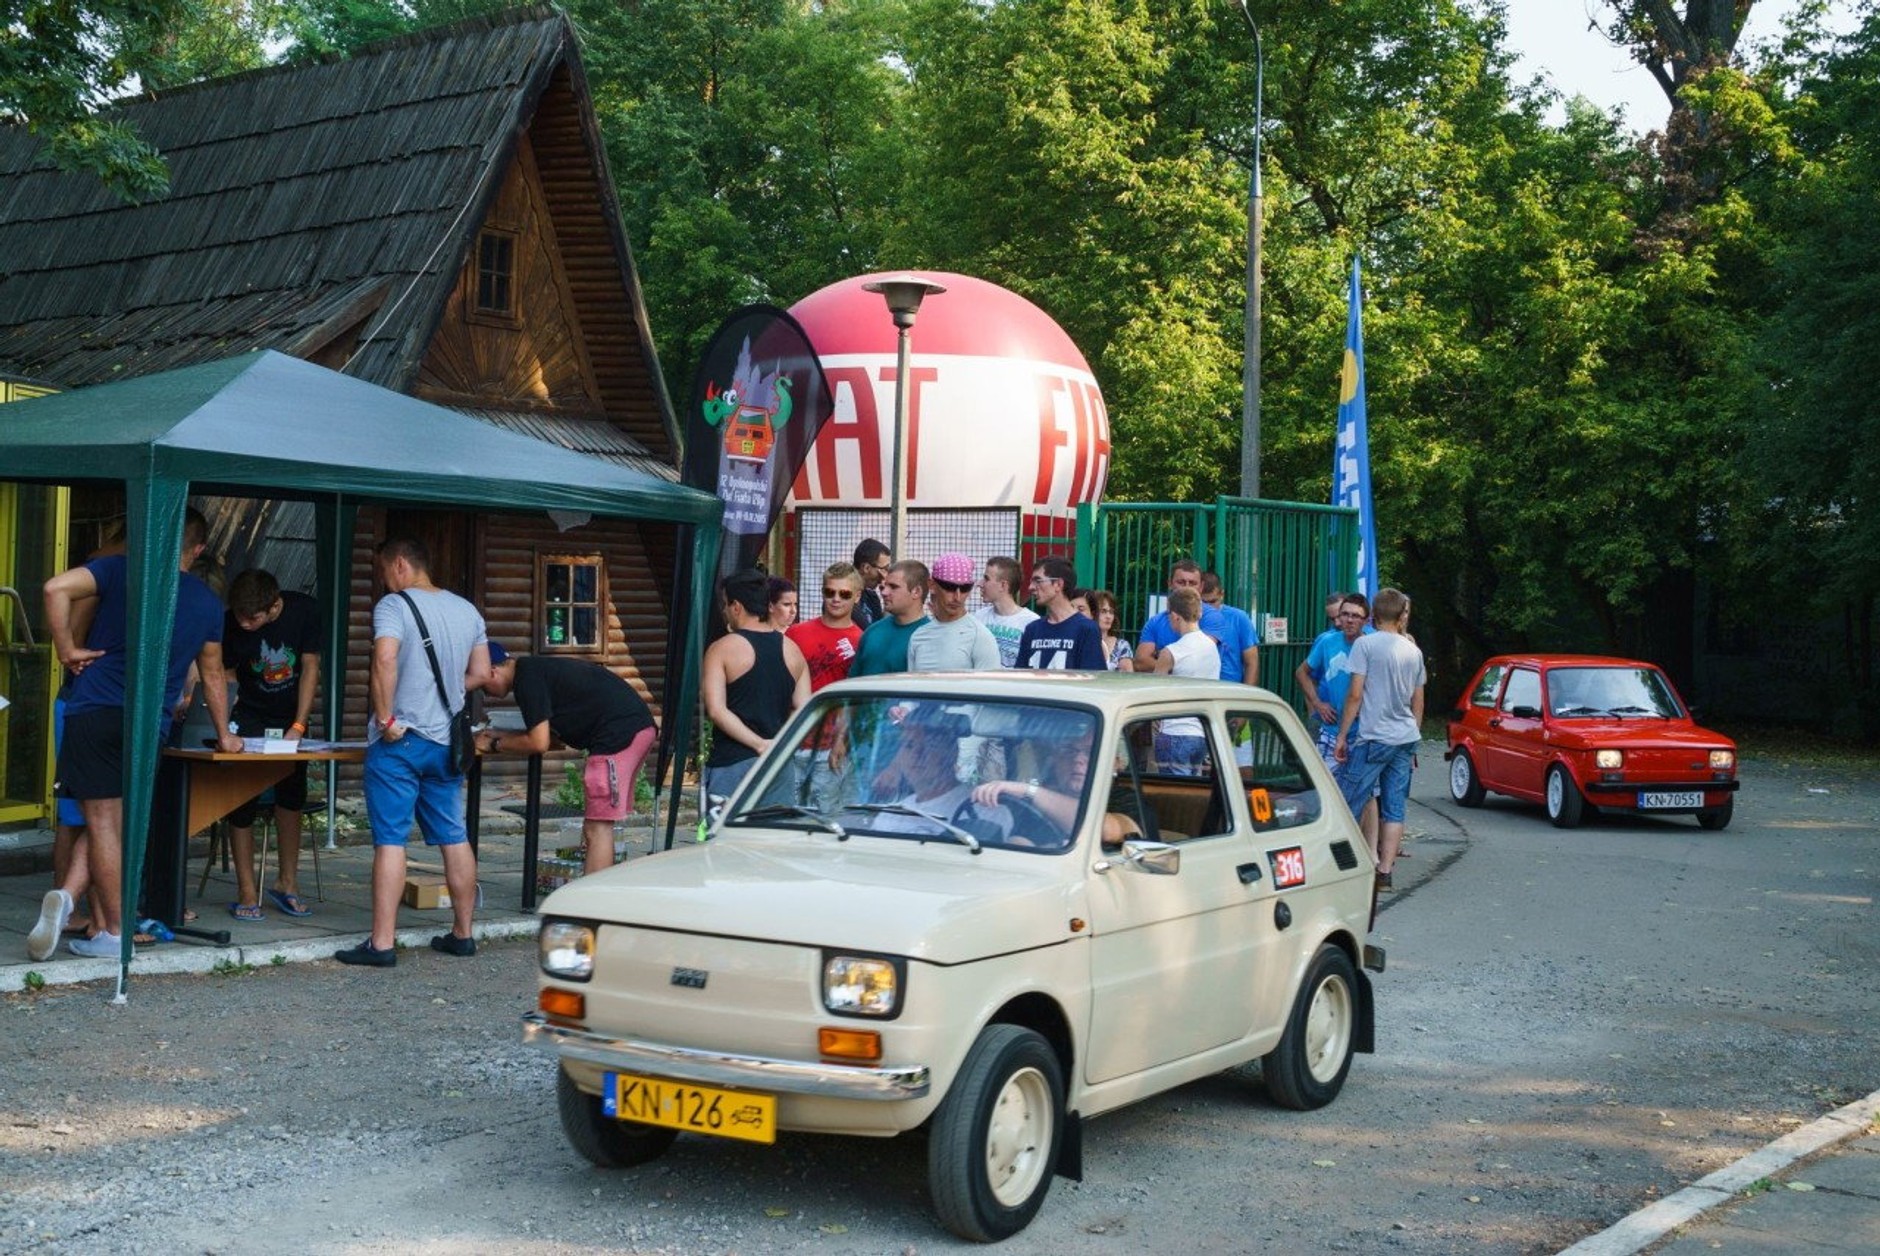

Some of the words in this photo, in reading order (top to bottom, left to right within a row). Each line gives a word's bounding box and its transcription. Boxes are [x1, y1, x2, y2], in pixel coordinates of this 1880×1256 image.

[1031, 639, 1062, 649] WELCOME
[1063, 639, 1074, 649] TO
[1666, 794, 1701, 806] 70551
[1276, 852, 1304, 883] 316
[621, 1079, 661, 1119] KN
[674, 1088, 723, 1129] 126
